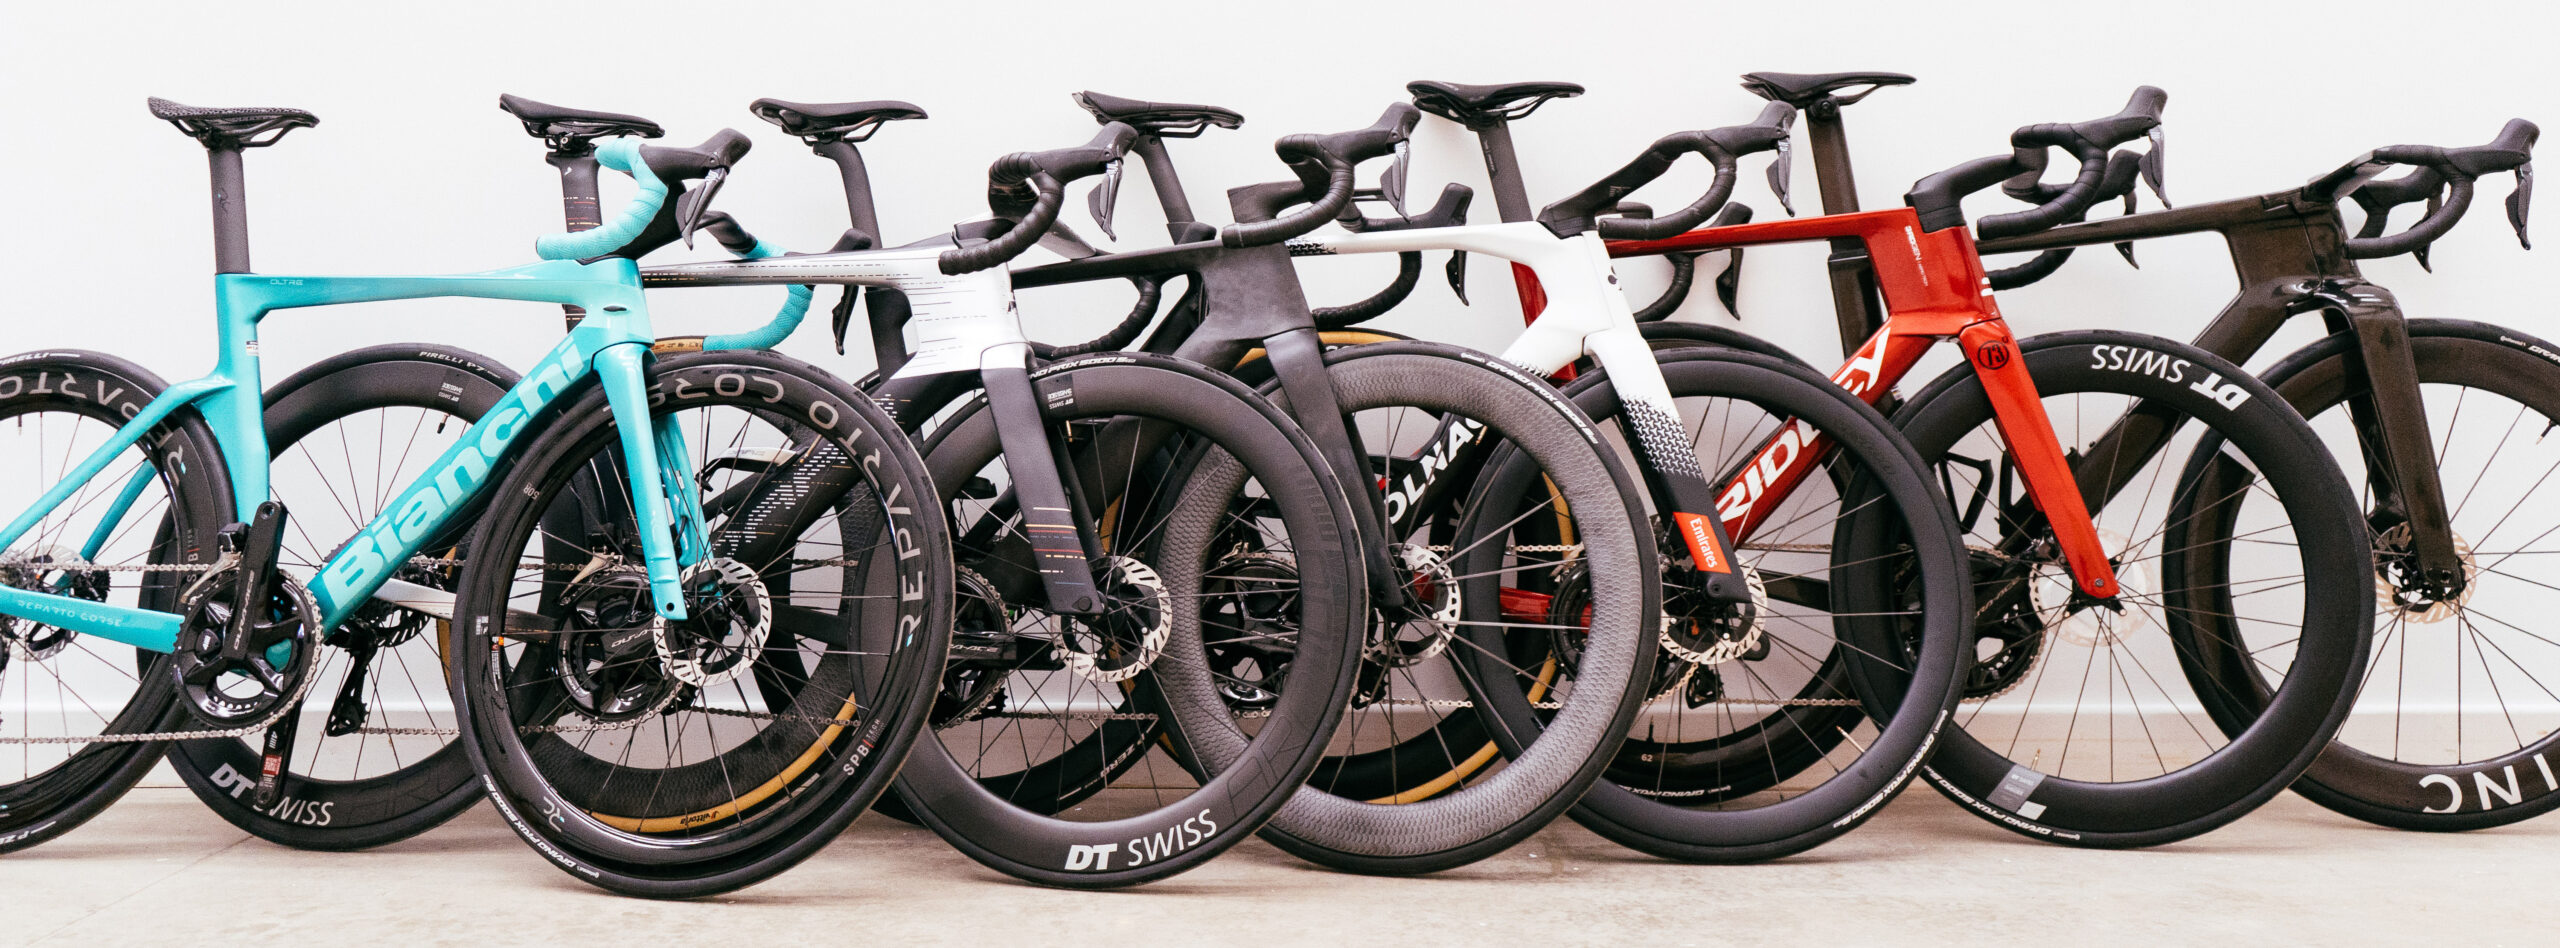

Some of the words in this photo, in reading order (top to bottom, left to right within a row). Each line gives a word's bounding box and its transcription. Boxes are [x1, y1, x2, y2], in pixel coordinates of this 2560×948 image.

[418, 351, 464, 365] PIRELLI
[2091, 345, 2190, 383] SWISS
[2190, 372, 2252, 412] DT
[322, 342, 585, 609] Bianchi
[808, 400, 924, 653] REPARTO
[1689, 517, 1718, 569] Emirates
[842, 743, 870, 776] SPB
[1641, 753, 1653, 763] 62
[209, 762, 256, 799] DT
[252, 796, 334, 826] WISS
[1064, 842, 1118, 871] DT
[1127, 808, 1217, 868] SWISS
